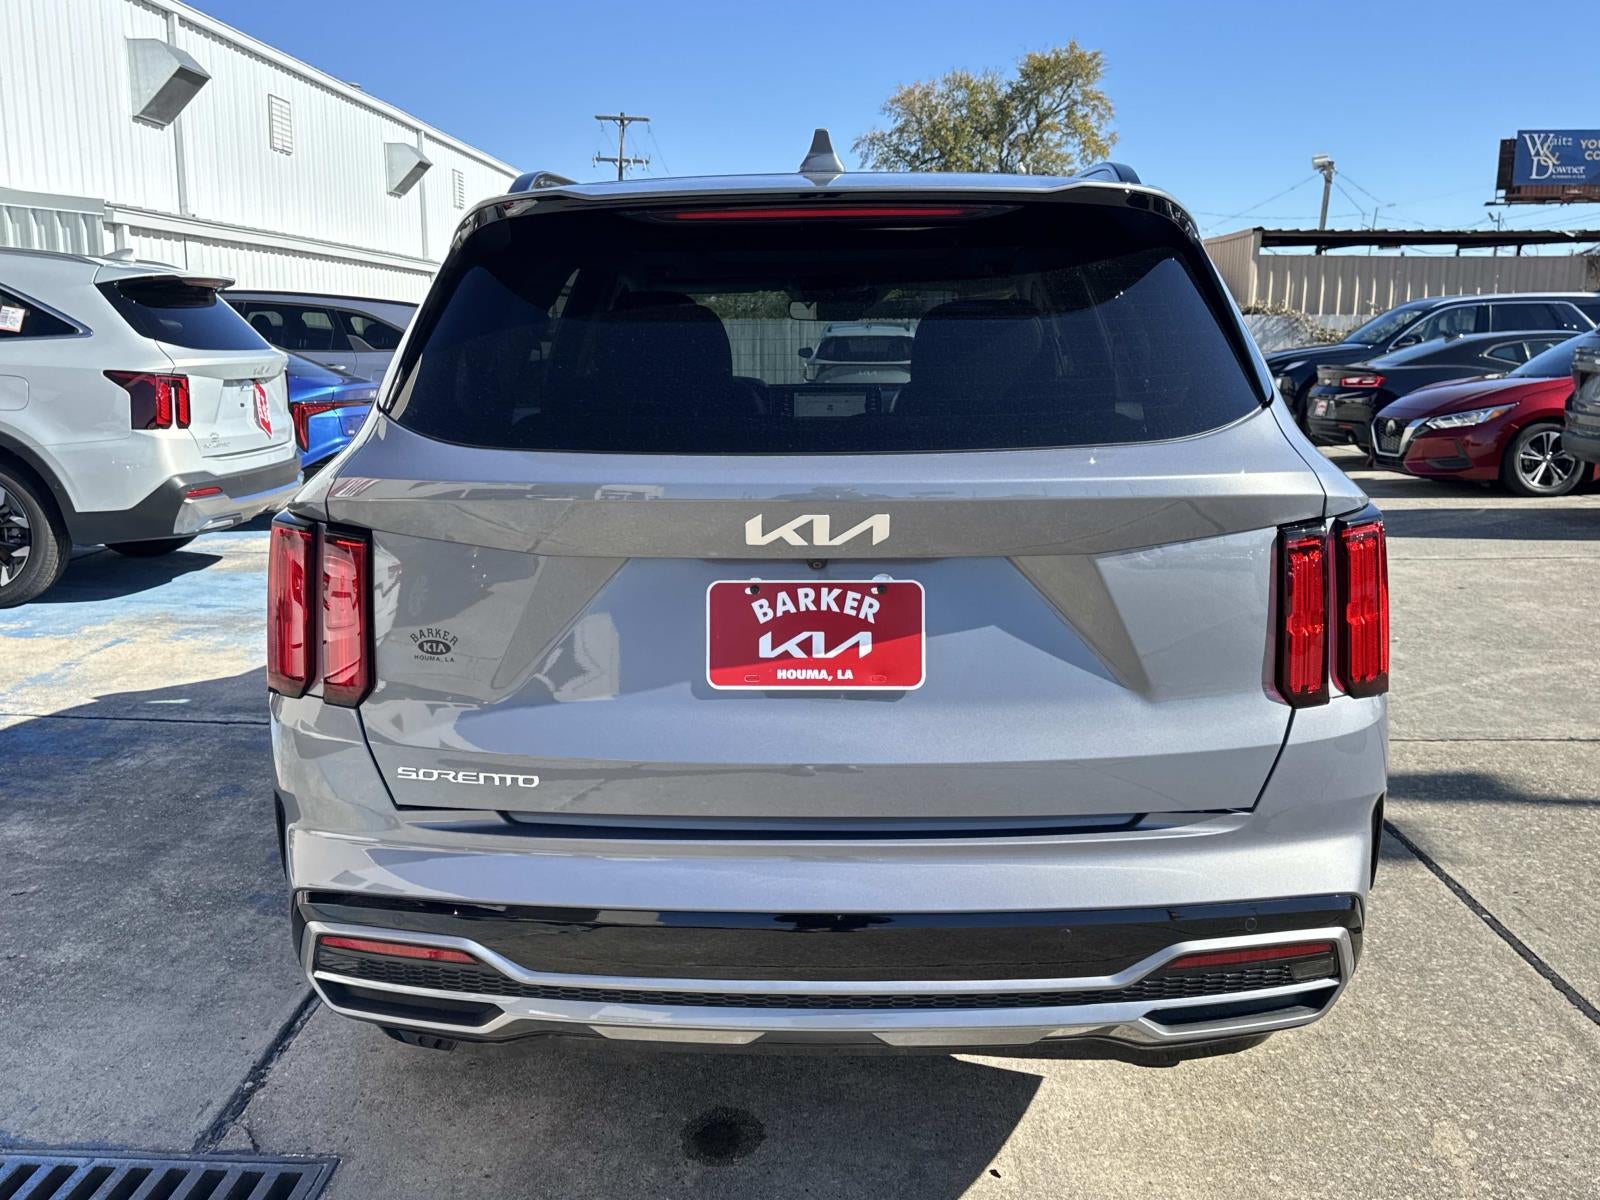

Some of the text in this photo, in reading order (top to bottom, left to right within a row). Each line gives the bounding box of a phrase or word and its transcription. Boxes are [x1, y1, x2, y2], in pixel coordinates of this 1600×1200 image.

[1529, 156, 1586, 179] Downer
[745, 514, 890, 546] KIA
[751, 587, 881, 625] BARKER
[410, 628, 459, 646] BARKER
[422, 642, 447, 653] KIA
[759, 631, 873, 659] KIA
[776, 668, 854, 681] HOUMA, LA
[397, 767, 540, 788] SORENTO
